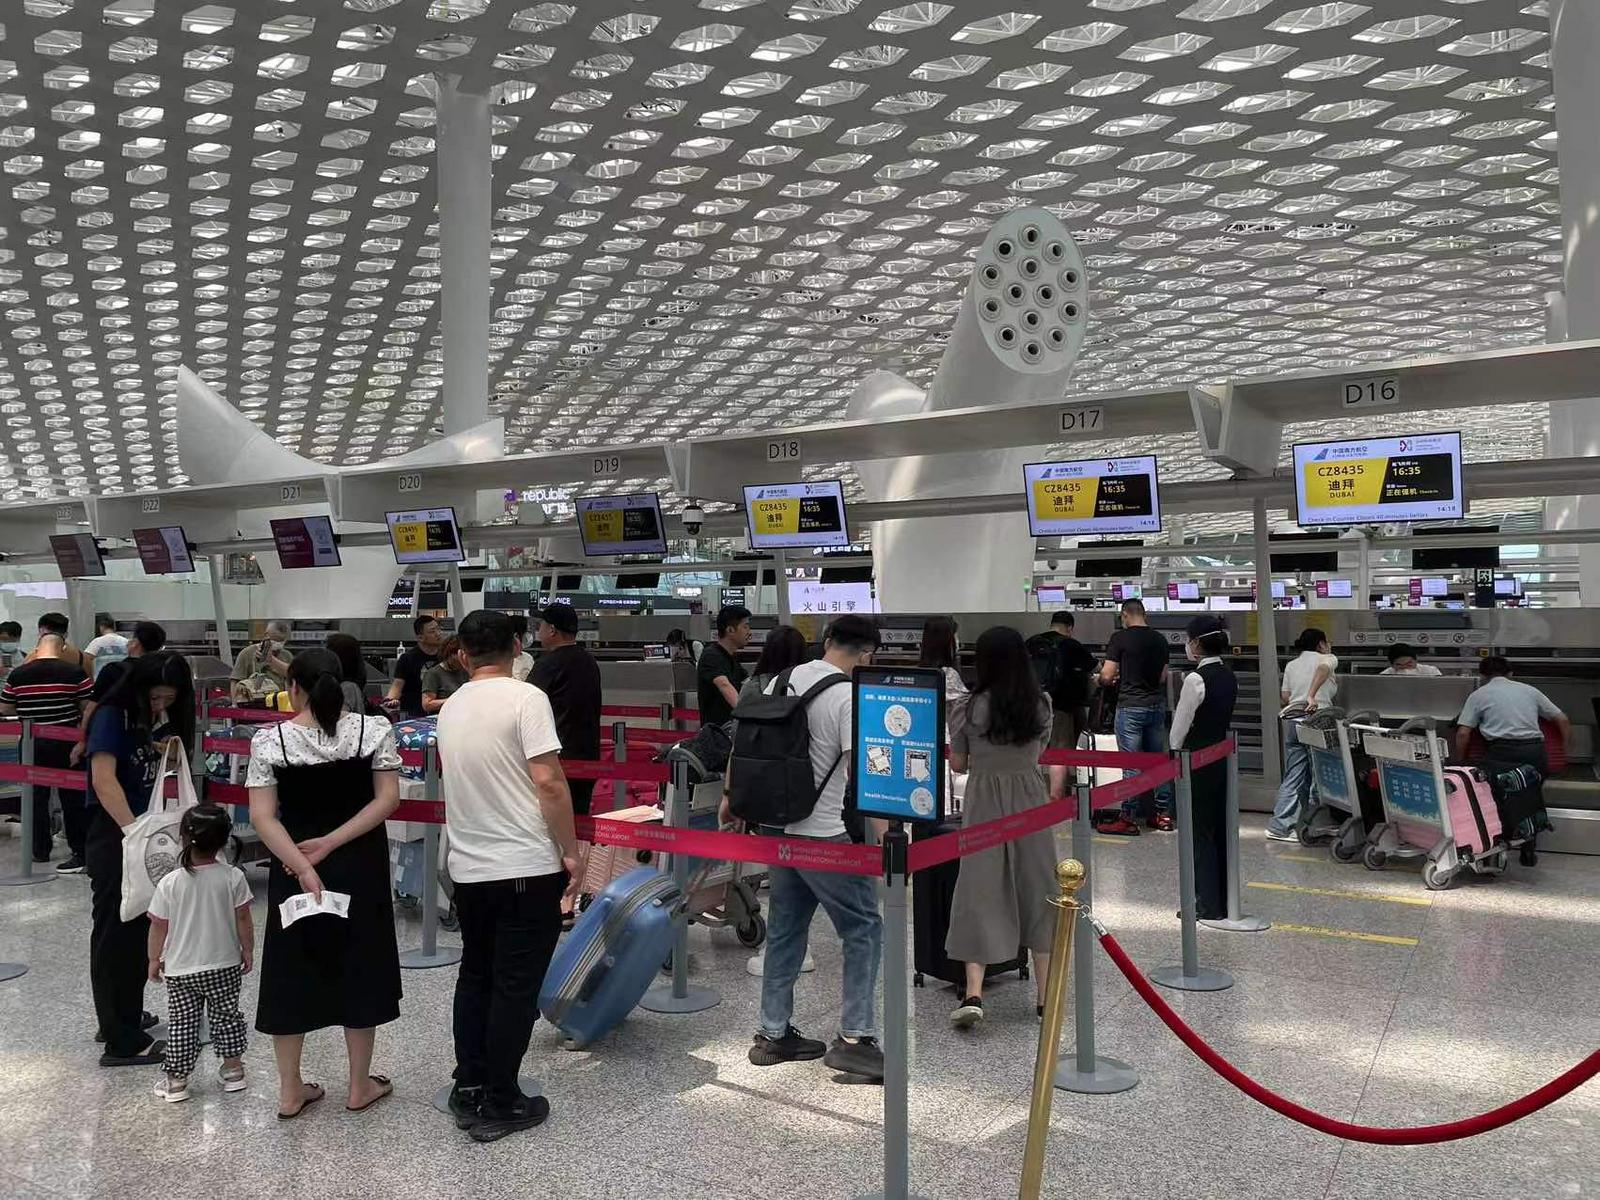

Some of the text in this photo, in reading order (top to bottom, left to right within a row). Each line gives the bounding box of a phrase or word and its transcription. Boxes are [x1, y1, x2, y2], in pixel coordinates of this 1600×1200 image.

[1345, 380, 1395, 404] D16
[1061, 410, 1100, 430] D17
[769, 442, 798, 459] D18
[594, 457, 619, 473] D19
[1318, 465, 1364, 476] CZ8435
[1392, 466, 1421, 476] 16:35
[399, 475, 421, 489] D20
[1044, 483, 1081, 494] CZ8435
[1327, 478, 1355, 491] 迪拜
[282, 485, 301, 500] D21
[523, 488, 570, 504] republic
[1103, 485, 1126, 494] 16:35
[143, 498, 159, 511] D22
[759, 502, 788, 512] CZ8435
[388, 597, 413, 605] CHOICE
[803, 600, 857, 612] 火山引擎
